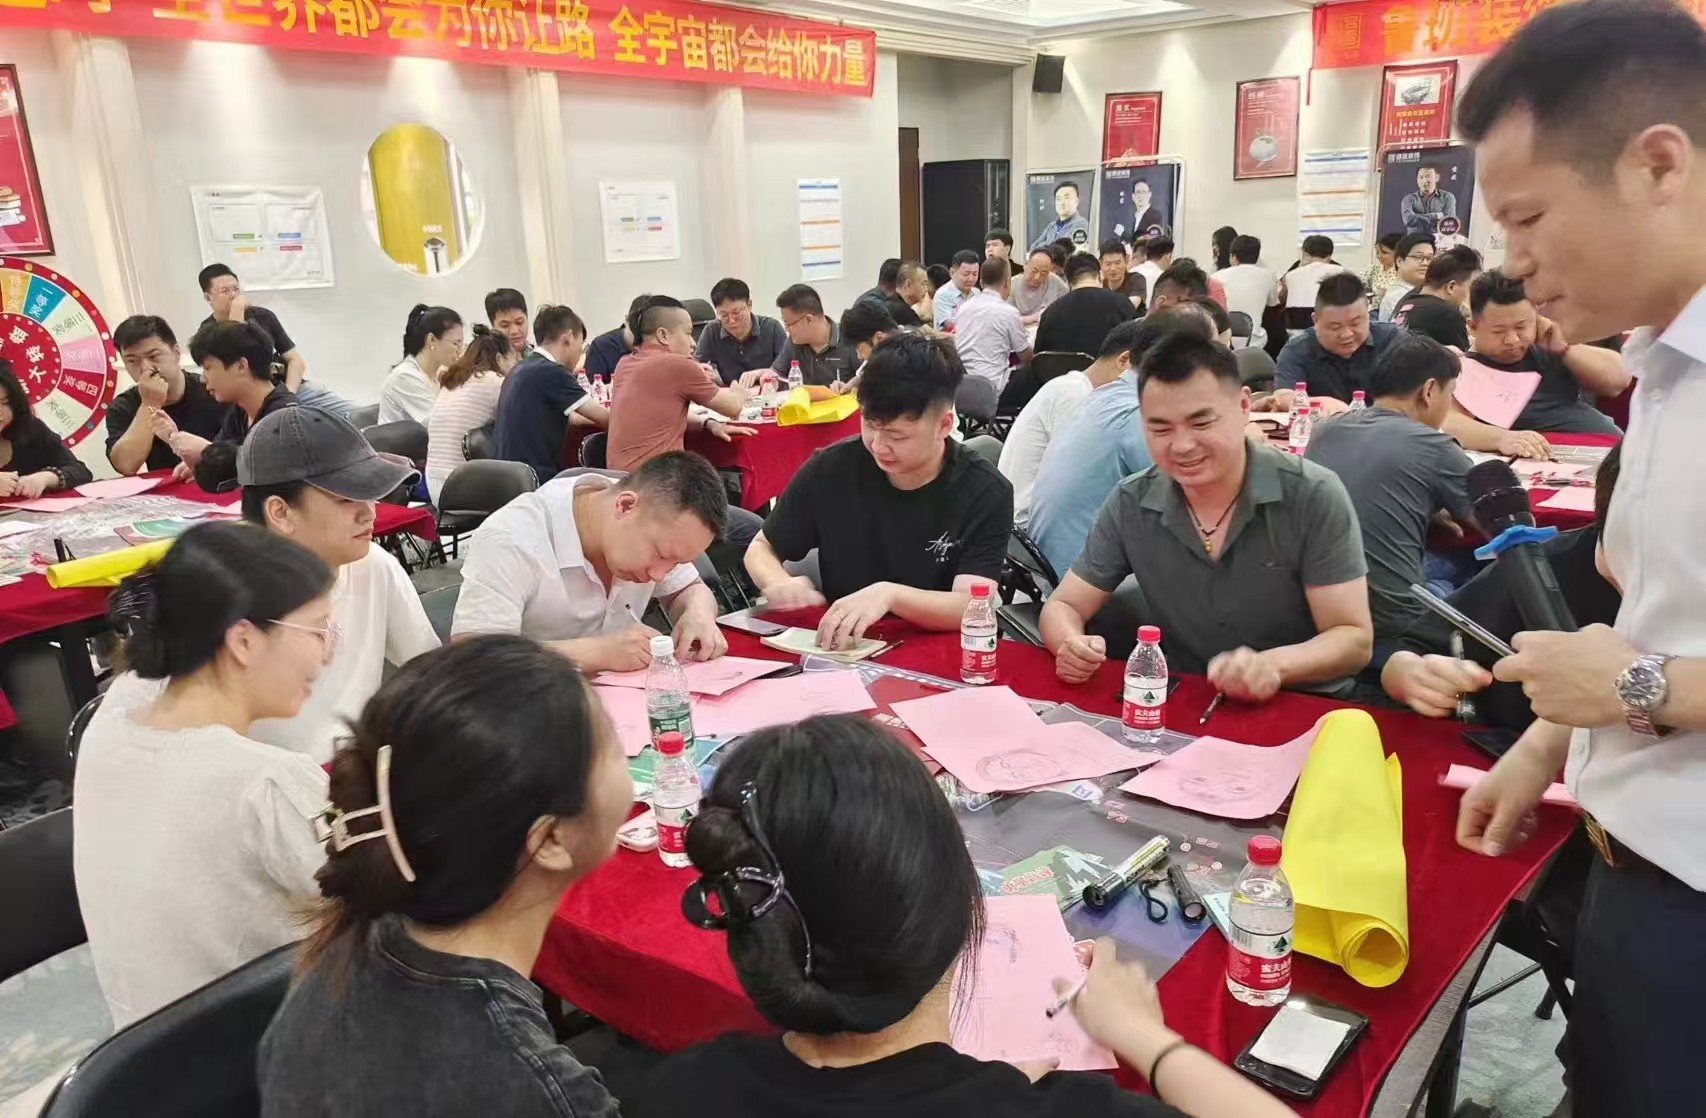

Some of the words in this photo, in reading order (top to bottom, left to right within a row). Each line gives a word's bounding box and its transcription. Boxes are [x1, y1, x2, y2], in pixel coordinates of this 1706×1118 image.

[153, 0, 596, 60] 都会为你让路
[608, 6, 867, 87] 全宇宙都会给你力量
[63, 374, 99, 397] 四等奖
